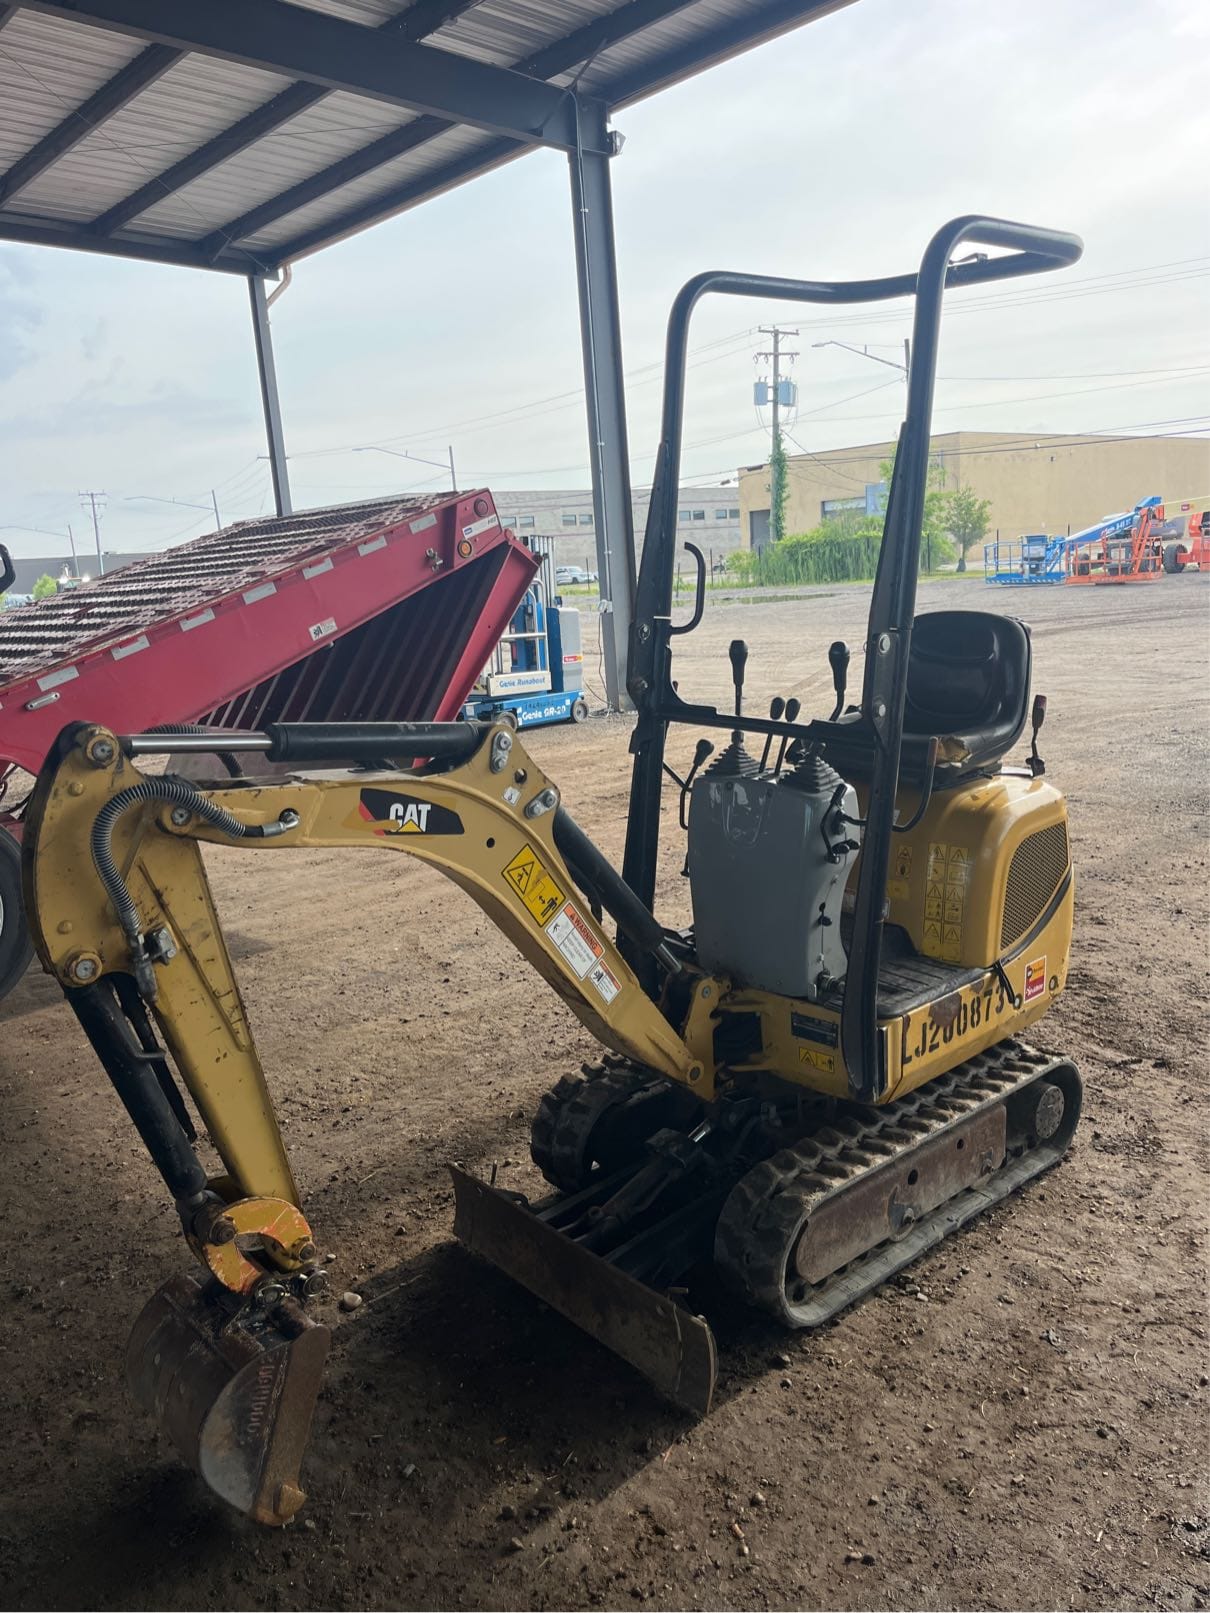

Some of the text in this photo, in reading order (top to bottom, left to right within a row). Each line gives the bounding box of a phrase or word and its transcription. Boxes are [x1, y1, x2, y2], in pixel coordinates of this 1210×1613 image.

[499, 677, 546, 688] Genie Runabout
[522, 709, 543, 720] Genie
[389, 803, 432, 832] CAT
[574, 918, 598, 949] WARNING
